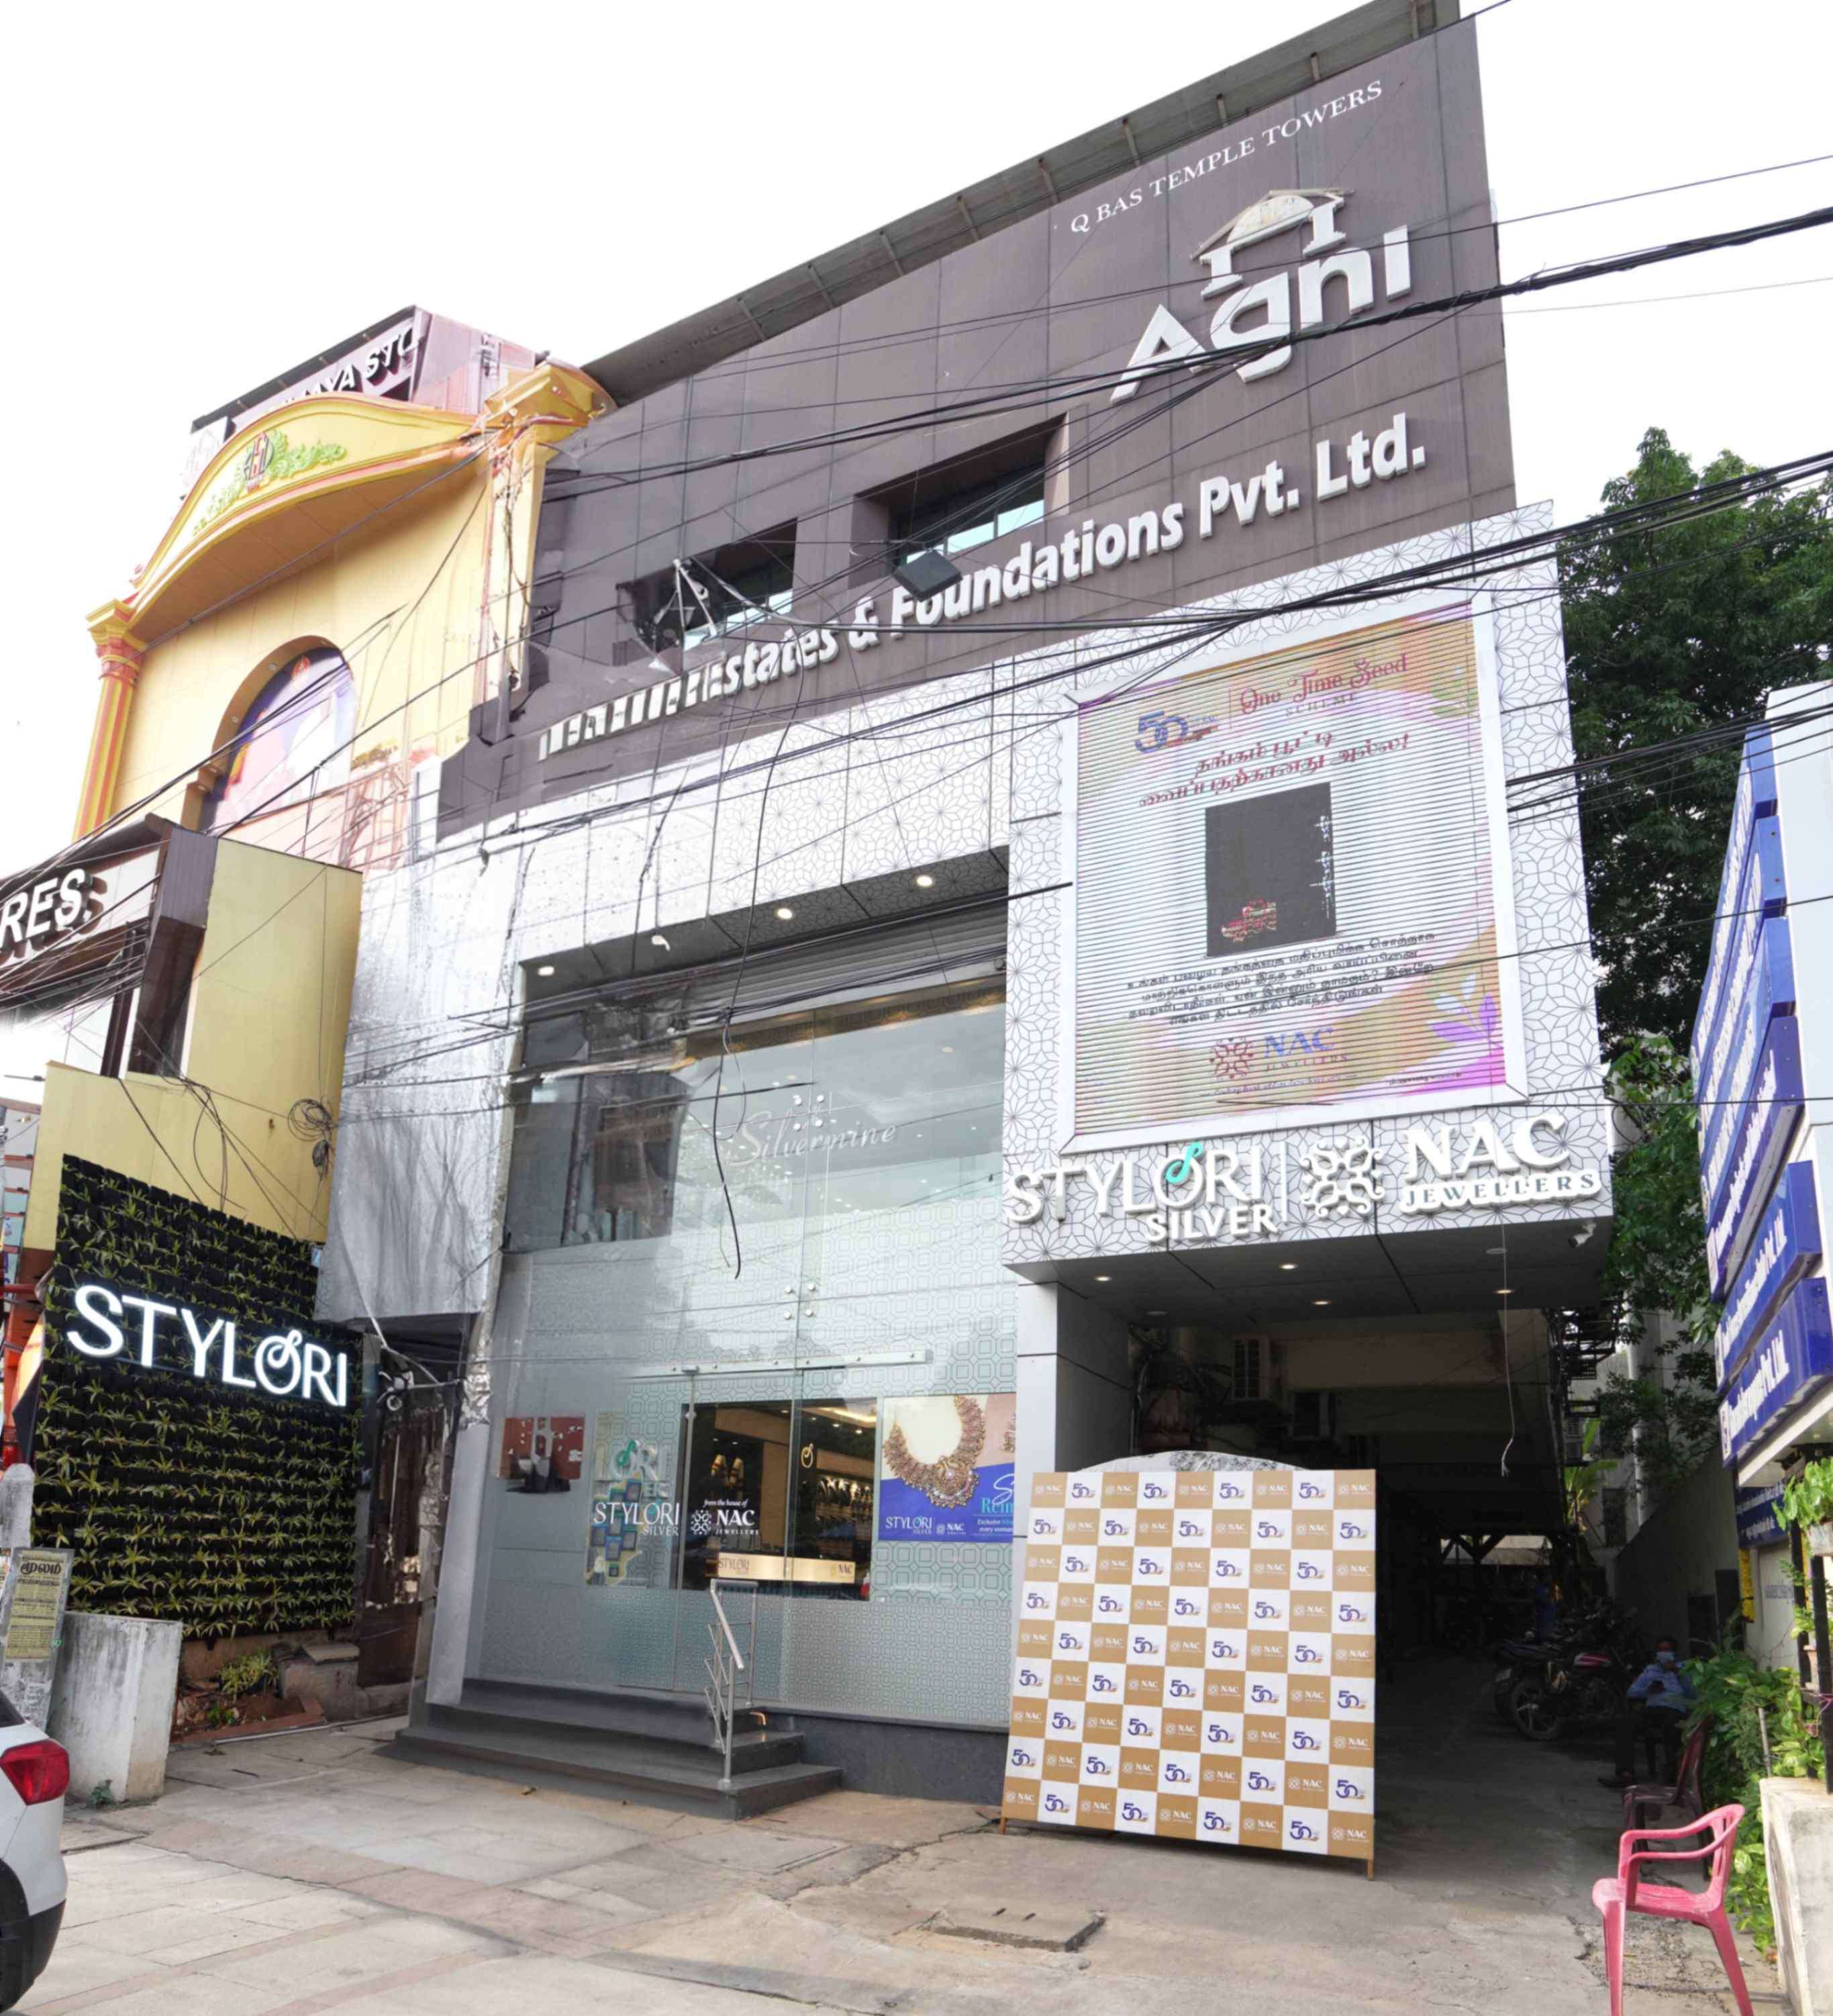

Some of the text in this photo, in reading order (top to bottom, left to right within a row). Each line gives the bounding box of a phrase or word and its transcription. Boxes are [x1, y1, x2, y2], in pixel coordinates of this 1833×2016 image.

[1096, 187, 1142, 224] BAS
[1148, 137, 1255, 199] TEMPLE
[1262, 80, 1383, 146] TOWERS
[1109, 224, 1411, 403] Agni
[849, 596, 881, 653] &
[889, 501, 1185, 640] Foundations
[1199, 459, 1301, 540] Pvt.
[1316, 412, 1427, 503] Ltd.
[1263, 1026, 1336, 1059] NAC
[1007, 1115, 1572, 1224] STYLORI NAC
[1144, 1171, 1599, 1243] SILVER JEWELLERS
[66, 1284, 348, 1408] STYLORI
[593, 1500, 680, 1526] STYLORI
[716, 1509, 756, 1527] NAC
[885, 1515, 965, 1532] STYLORI NAC
[642, 1525, 679, 1537] SILVER
[715, 1528, 760, 1536] JEWELLERS
[1186, 1561, 1204, 1569] NAC
[1266, 1563, 1284, 1571] NAC
[1350, 1565, 1369, 1573] NAC
[1071, 1596, 1088, 1604] NAC
[1146, 1599, 1163, 1607] NAC
[1224, 1602, 1242, 1611] NAC
[1306, 1605, 1326, 1613] NAC
[1032, 1633, 1048, 1641] NAC
[1105, 1637, 1122, 1645] NAC
[1182, 1641, 1200, 1649] NAC
[1263, 1645, 1282, 1653] NAC
[1349, 1649, 1369, 1658] NAC
[1064, 1674, 1082, 1683] NAC
[1140, 1679, 1158, 1688] NAC
[1220, 1684, 1239, 1693] NAC
[1304, 1690, 1324, 1699] NAC
[1025, 1712, 1042, 1721] NAC
[1099, 1717, 1117, 1727] NAC
[1177, 1723, 1196, 1733] NAC
[1260, 1730, 1279, 1739] NAC
[1348, 1737, 1368, 1747] NAC
[1058, 1756, 1075, 1765] NAC
[1135, 1762, 1153, 1772] NAC
[1216, 1770, 1236, 1780] NAC
[1302, 1778, 1322, 1788] NAC
[1018, 1793, 1034, 1803] NAC
[1093, 1801, 1111, 1811] NAC
[1173, 1810, 1191, 1820] NAC
[1257, 1819, 1277, 1829] NAC
[1346, 1829, 1367, 1839] NAC
